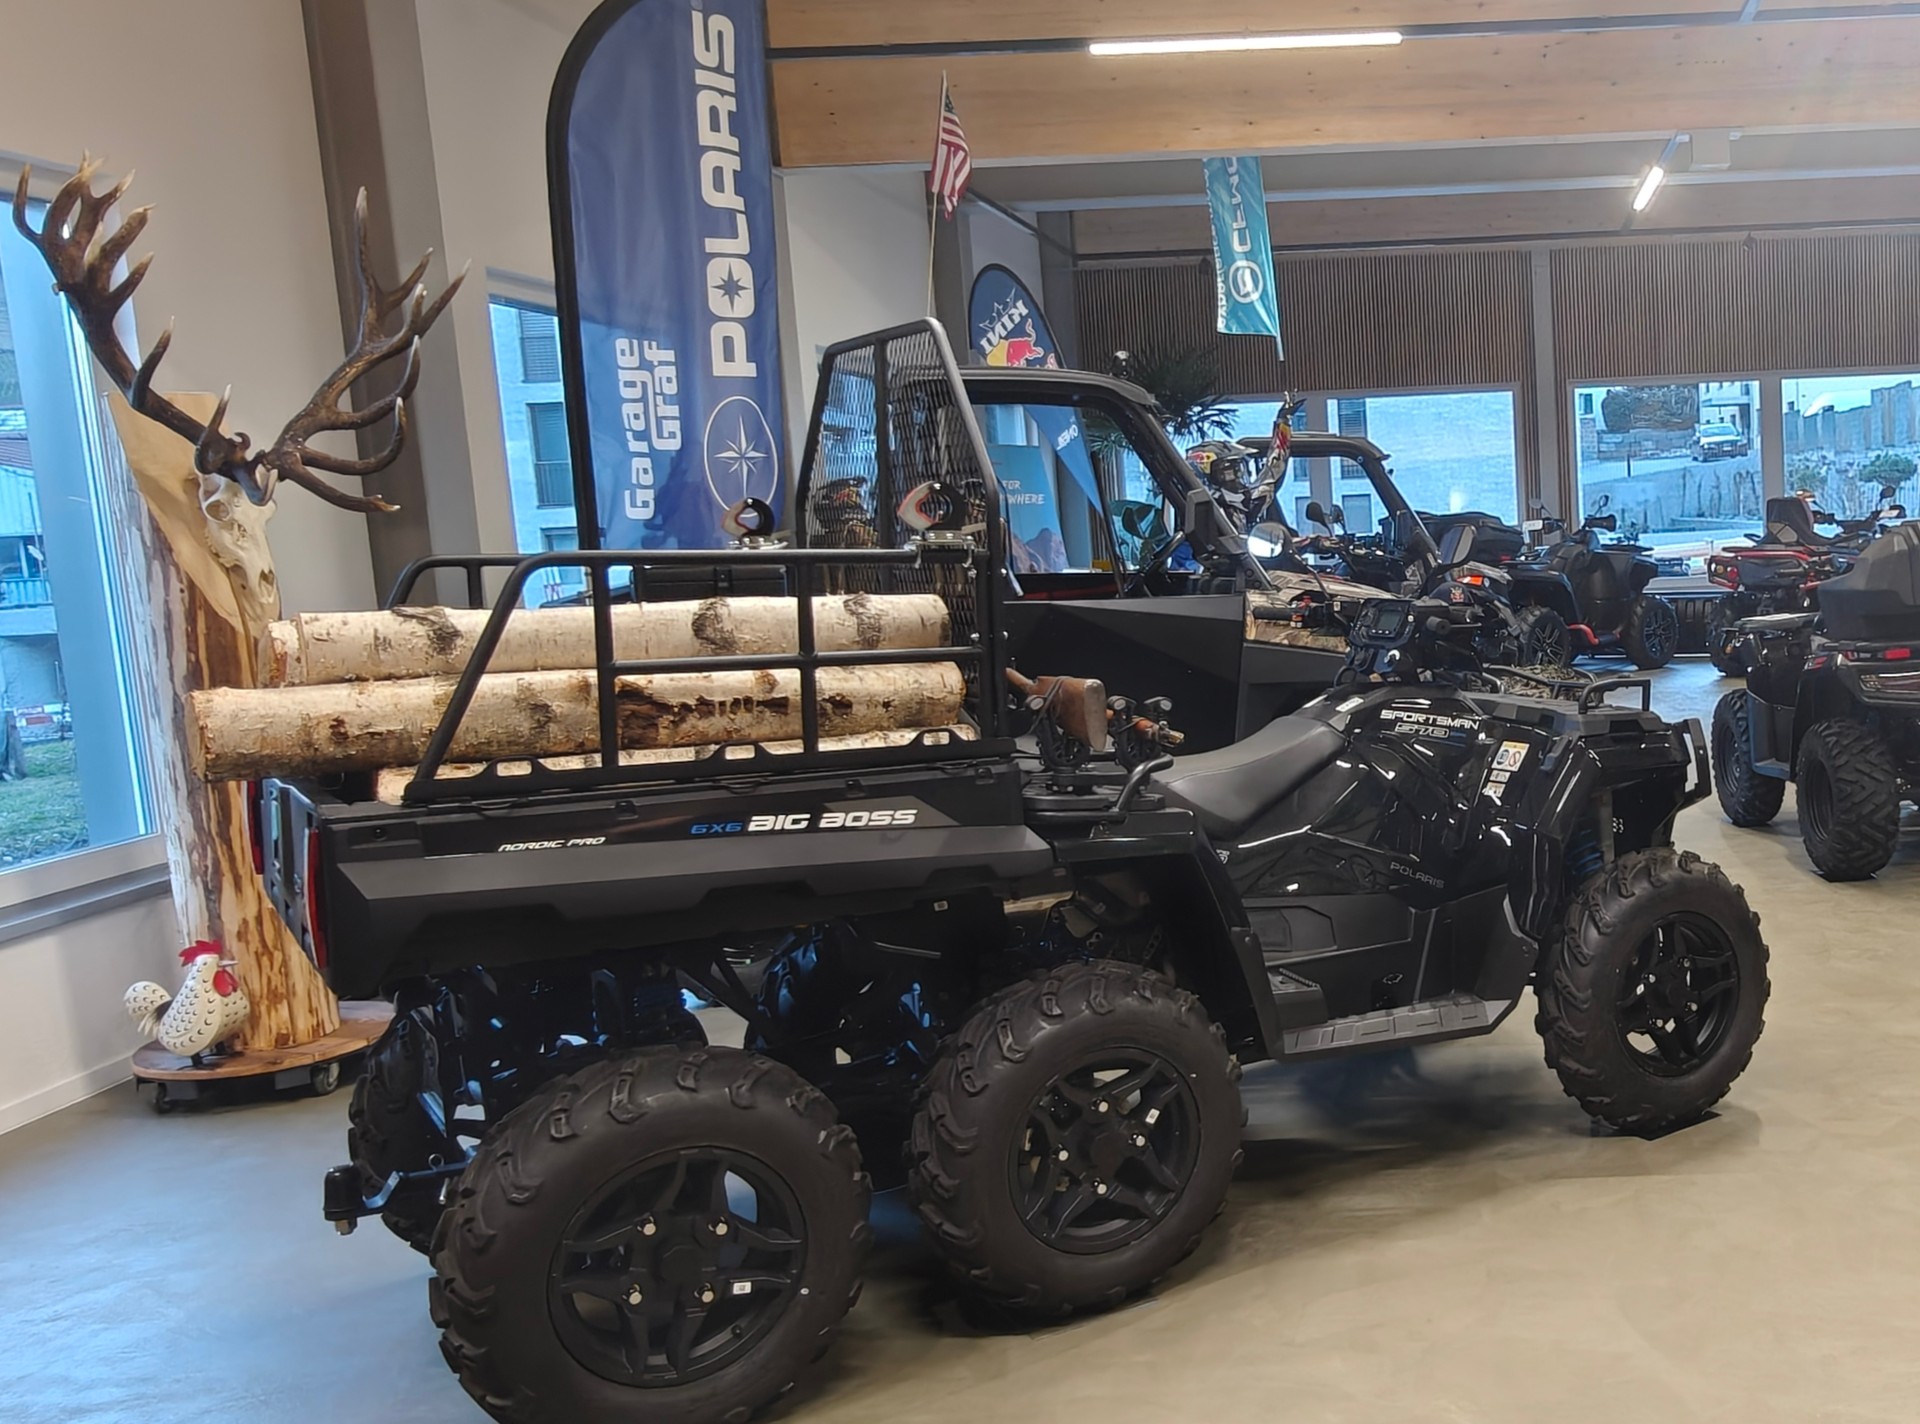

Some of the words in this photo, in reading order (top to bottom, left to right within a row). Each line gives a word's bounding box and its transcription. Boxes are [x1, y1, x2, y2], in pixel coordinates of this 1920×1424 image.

[691, 8, 757, 379] POLARIS
[643, 340, 682, 451] Graf
[614, 338, 655, 520] Garage
[1007, 493, 1046, 505] WHERE
[1380, 709, 1480, 730] SPORTSMAN
[1394, 722, 1450, 738] 570
[747, 813, 811, 832] BIG
[819, 809, 918, 829] BOSS
[498, 839, 563, 852] NORDIC
[566, 836, 606, 848] PRO
[1390, 861, 1445, 888] POLARIS
